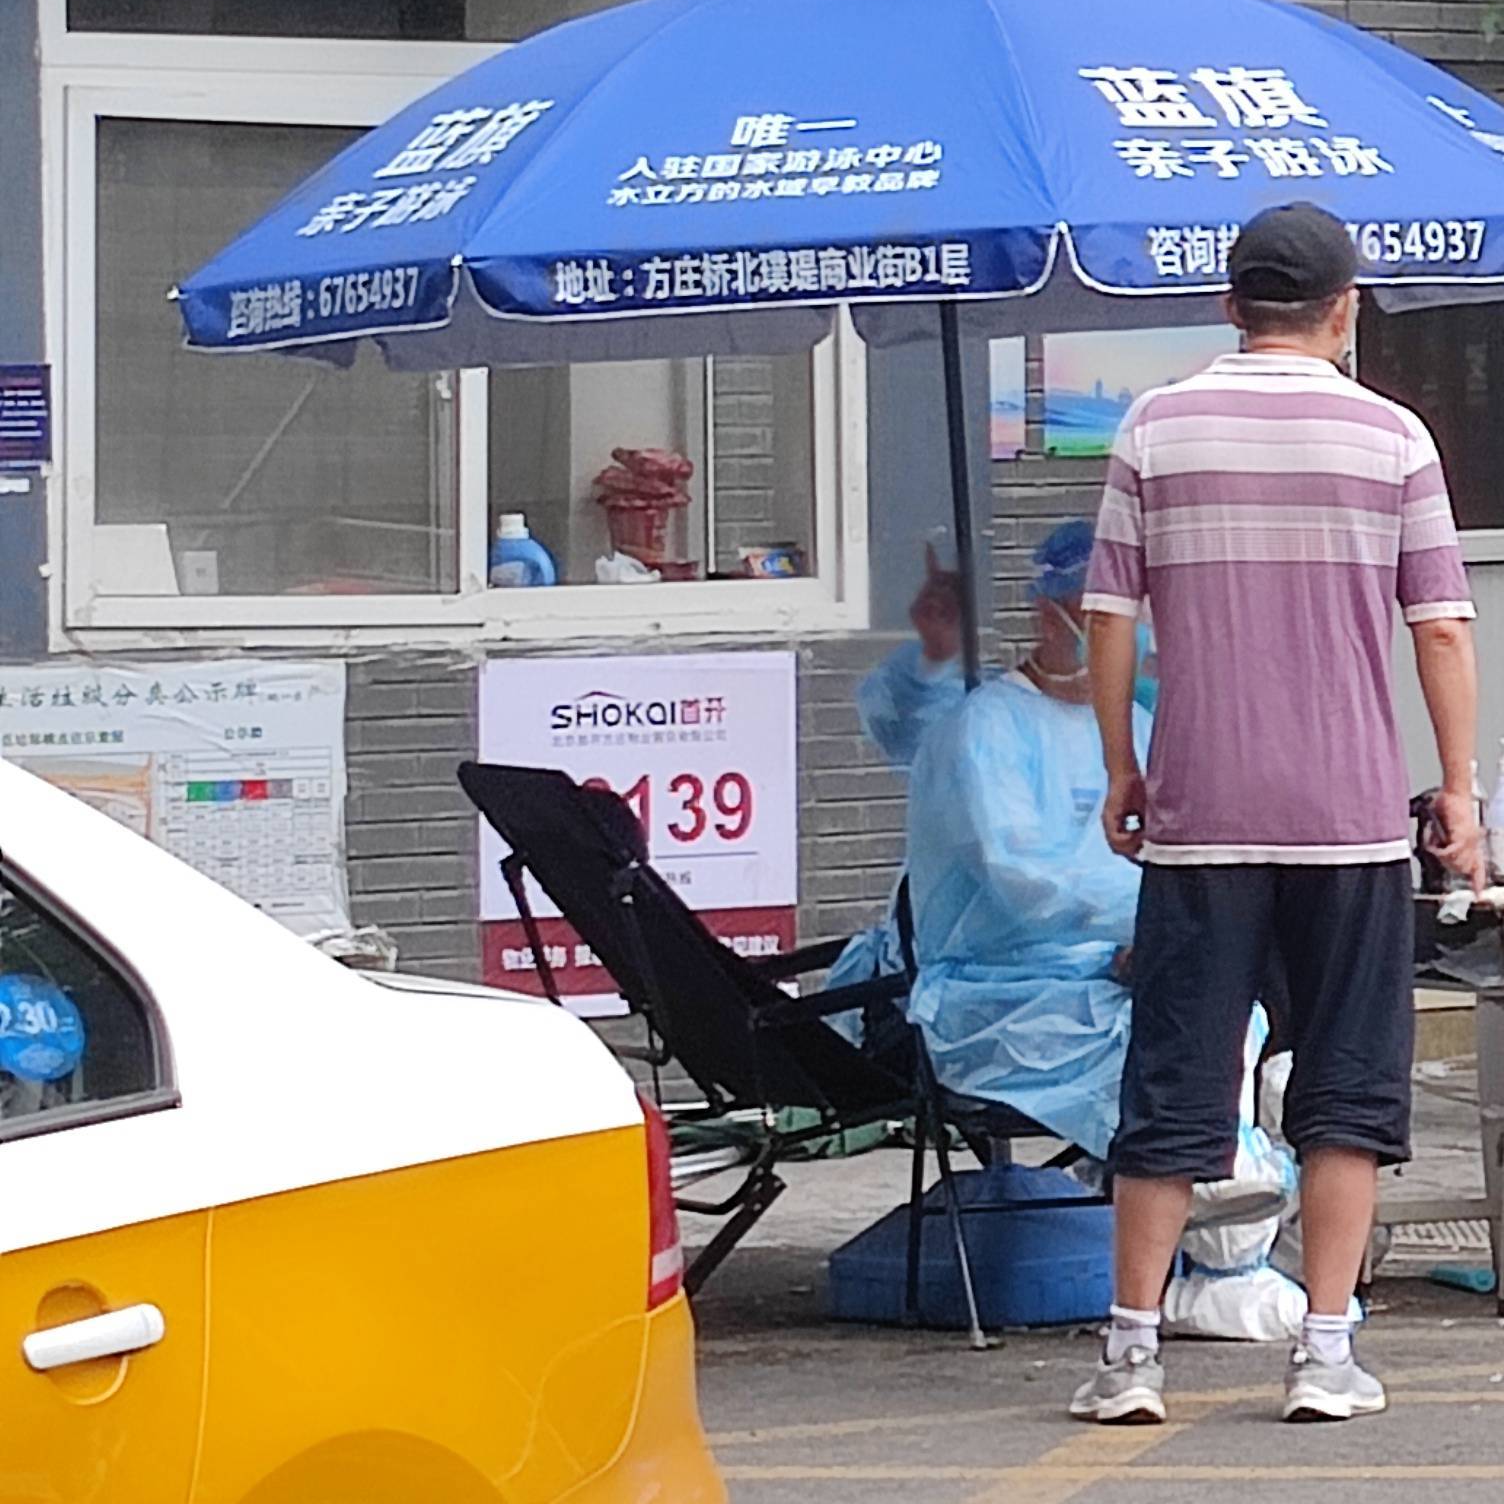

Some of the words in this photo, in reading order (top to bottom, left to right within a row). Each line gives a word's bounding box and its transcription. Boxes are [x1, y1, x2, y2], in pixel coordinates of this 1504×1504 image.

[1077, 66, 1330, 128] 蓝旗
[730, 112, 857, 147] 唯一
[1112, 136, 1396, 178] 亲子游泳
